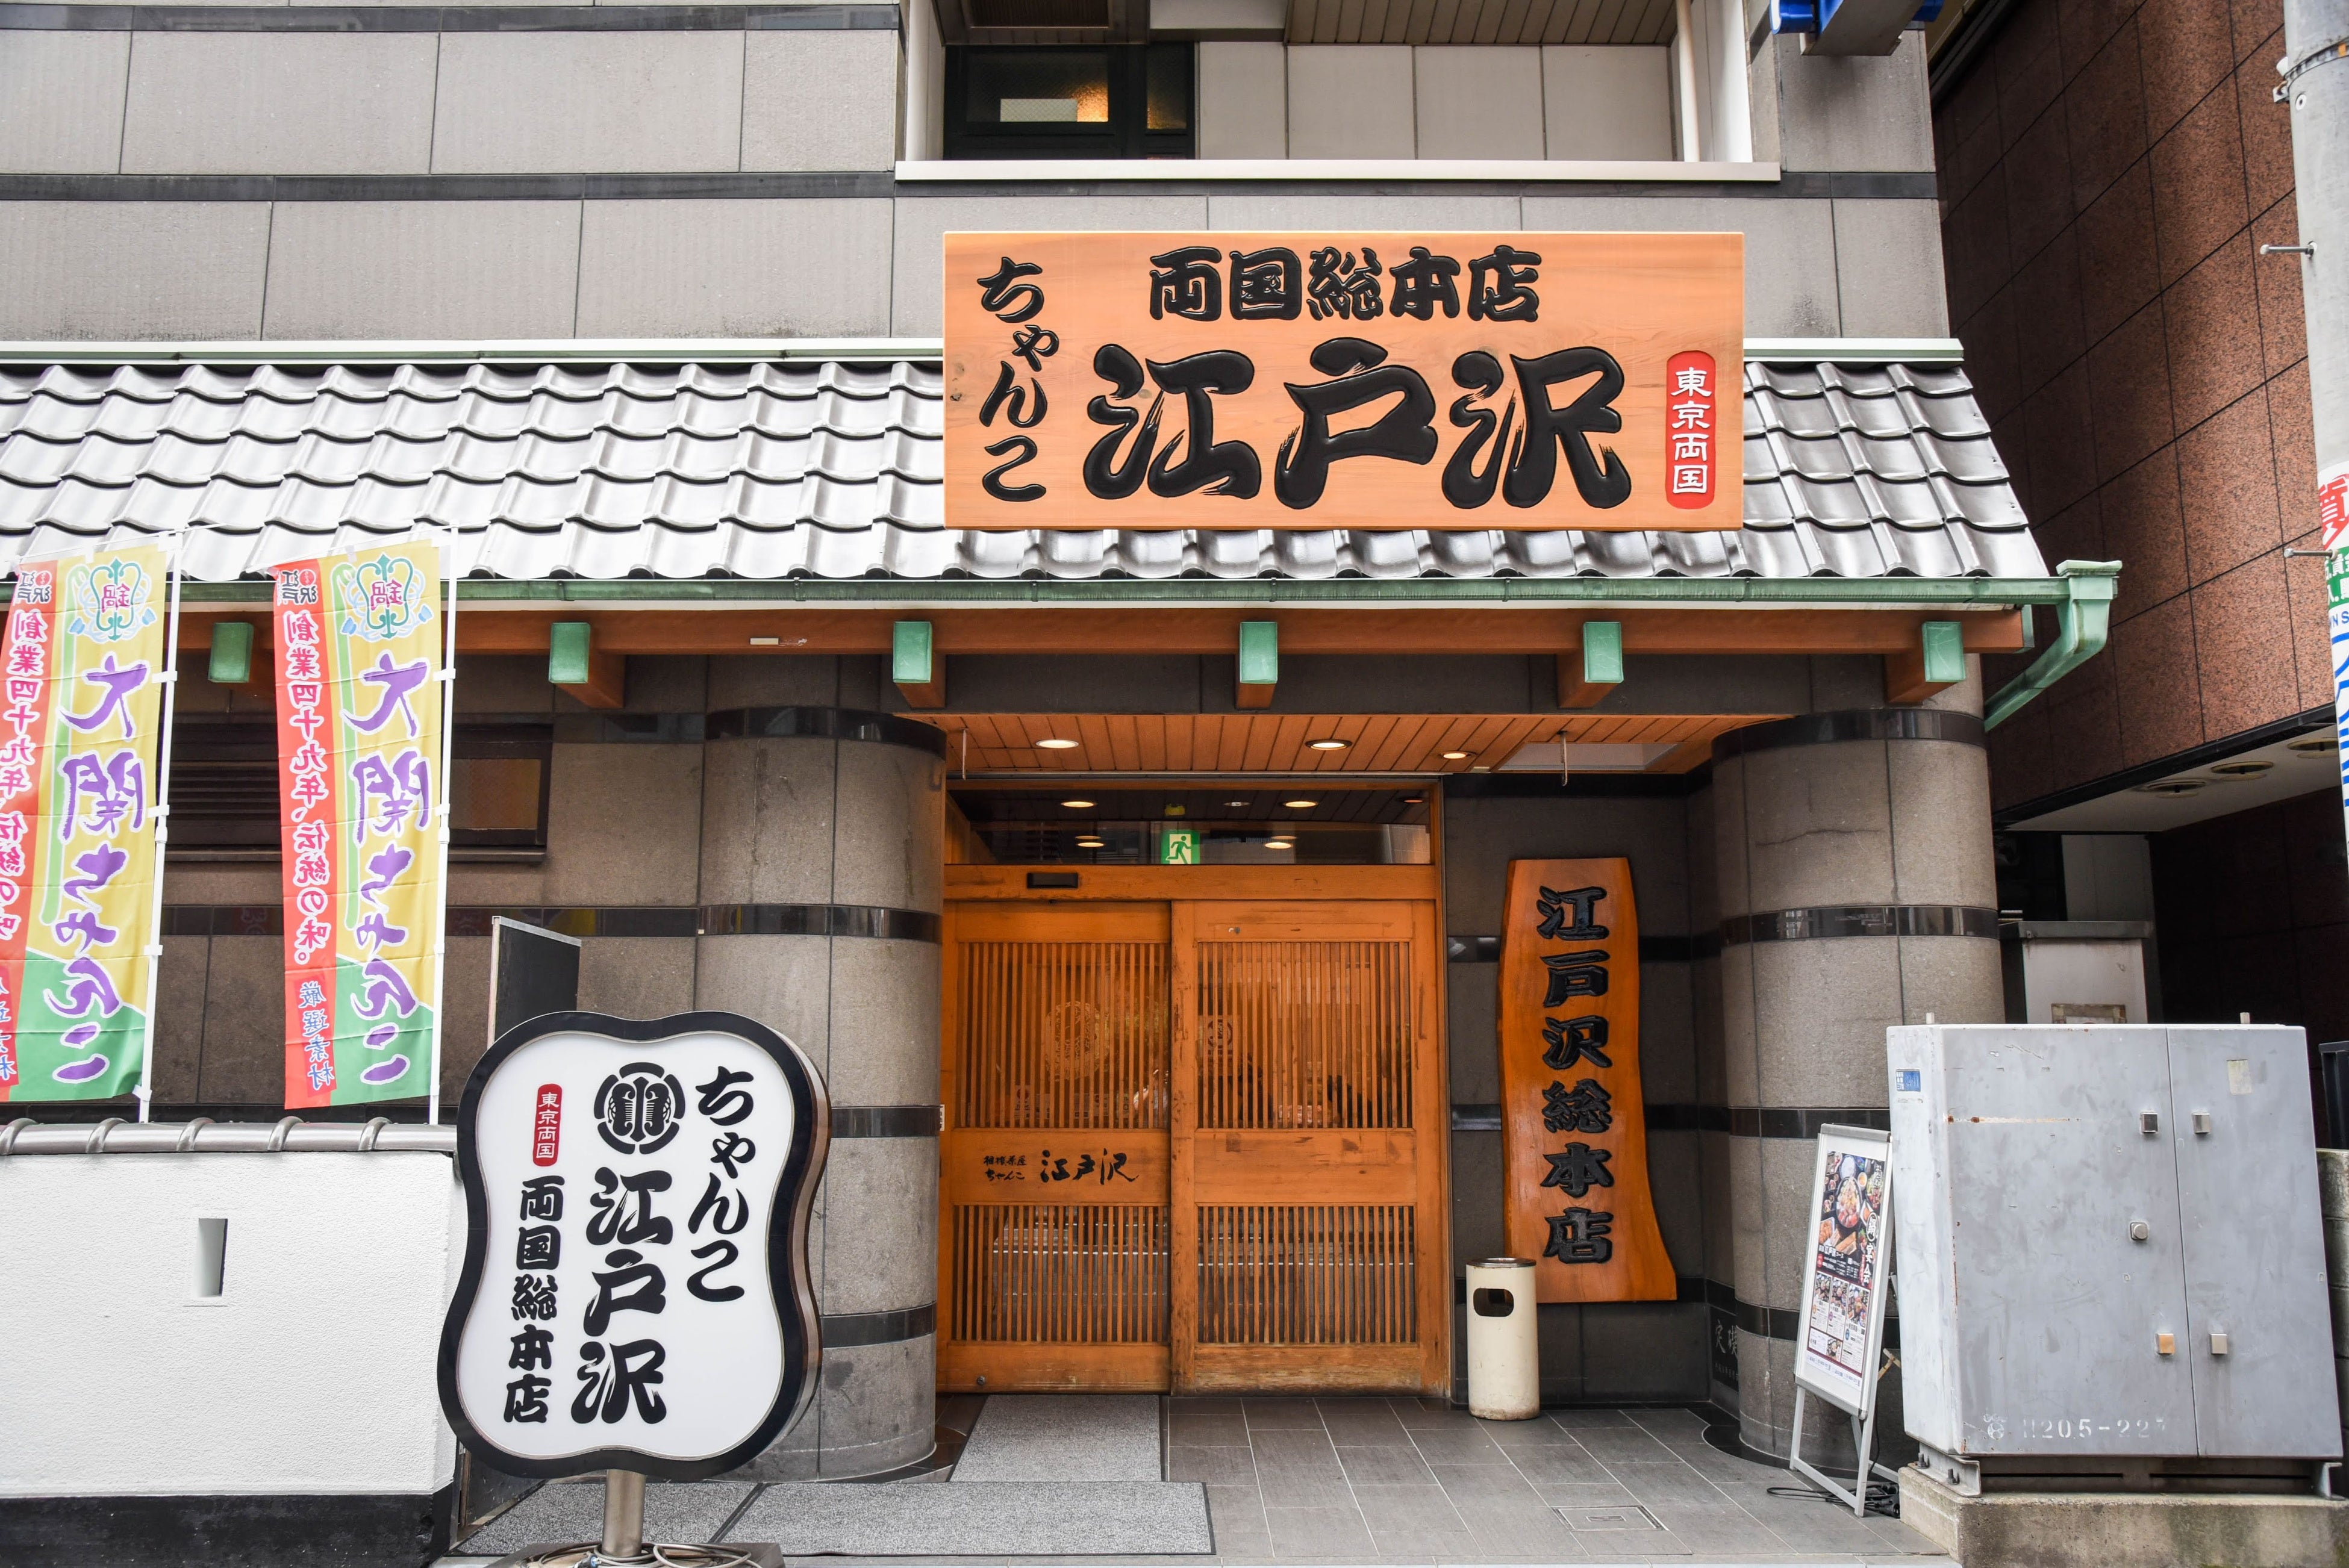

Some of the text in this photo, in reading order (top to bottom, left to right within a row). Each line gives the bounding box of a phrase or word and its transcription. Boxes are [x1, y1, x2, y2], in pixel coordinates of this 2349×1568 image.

[1150, 245, 1542, 323] 両国総本店
[977, 256, 1060, 502] ちゃんこ
[1083, 337, 1632, 509] 江戸沢
[1669, 366, 1712, 494] 東京両国
[536, 1092, 560, 1160] 東京両国
[1536, 886, 1615, 1264] 江戸沢総本店
[687, 1066, 756, 1302] ちゃんこ
[985, 1168, 1026, 1182] ちゃんこ
[1040, 1148, 1140, 1186] 江戸沢
[504, 1175, 565, 1423] 両国総本店
[570, 1167, 673, 1424] 江戸沢
